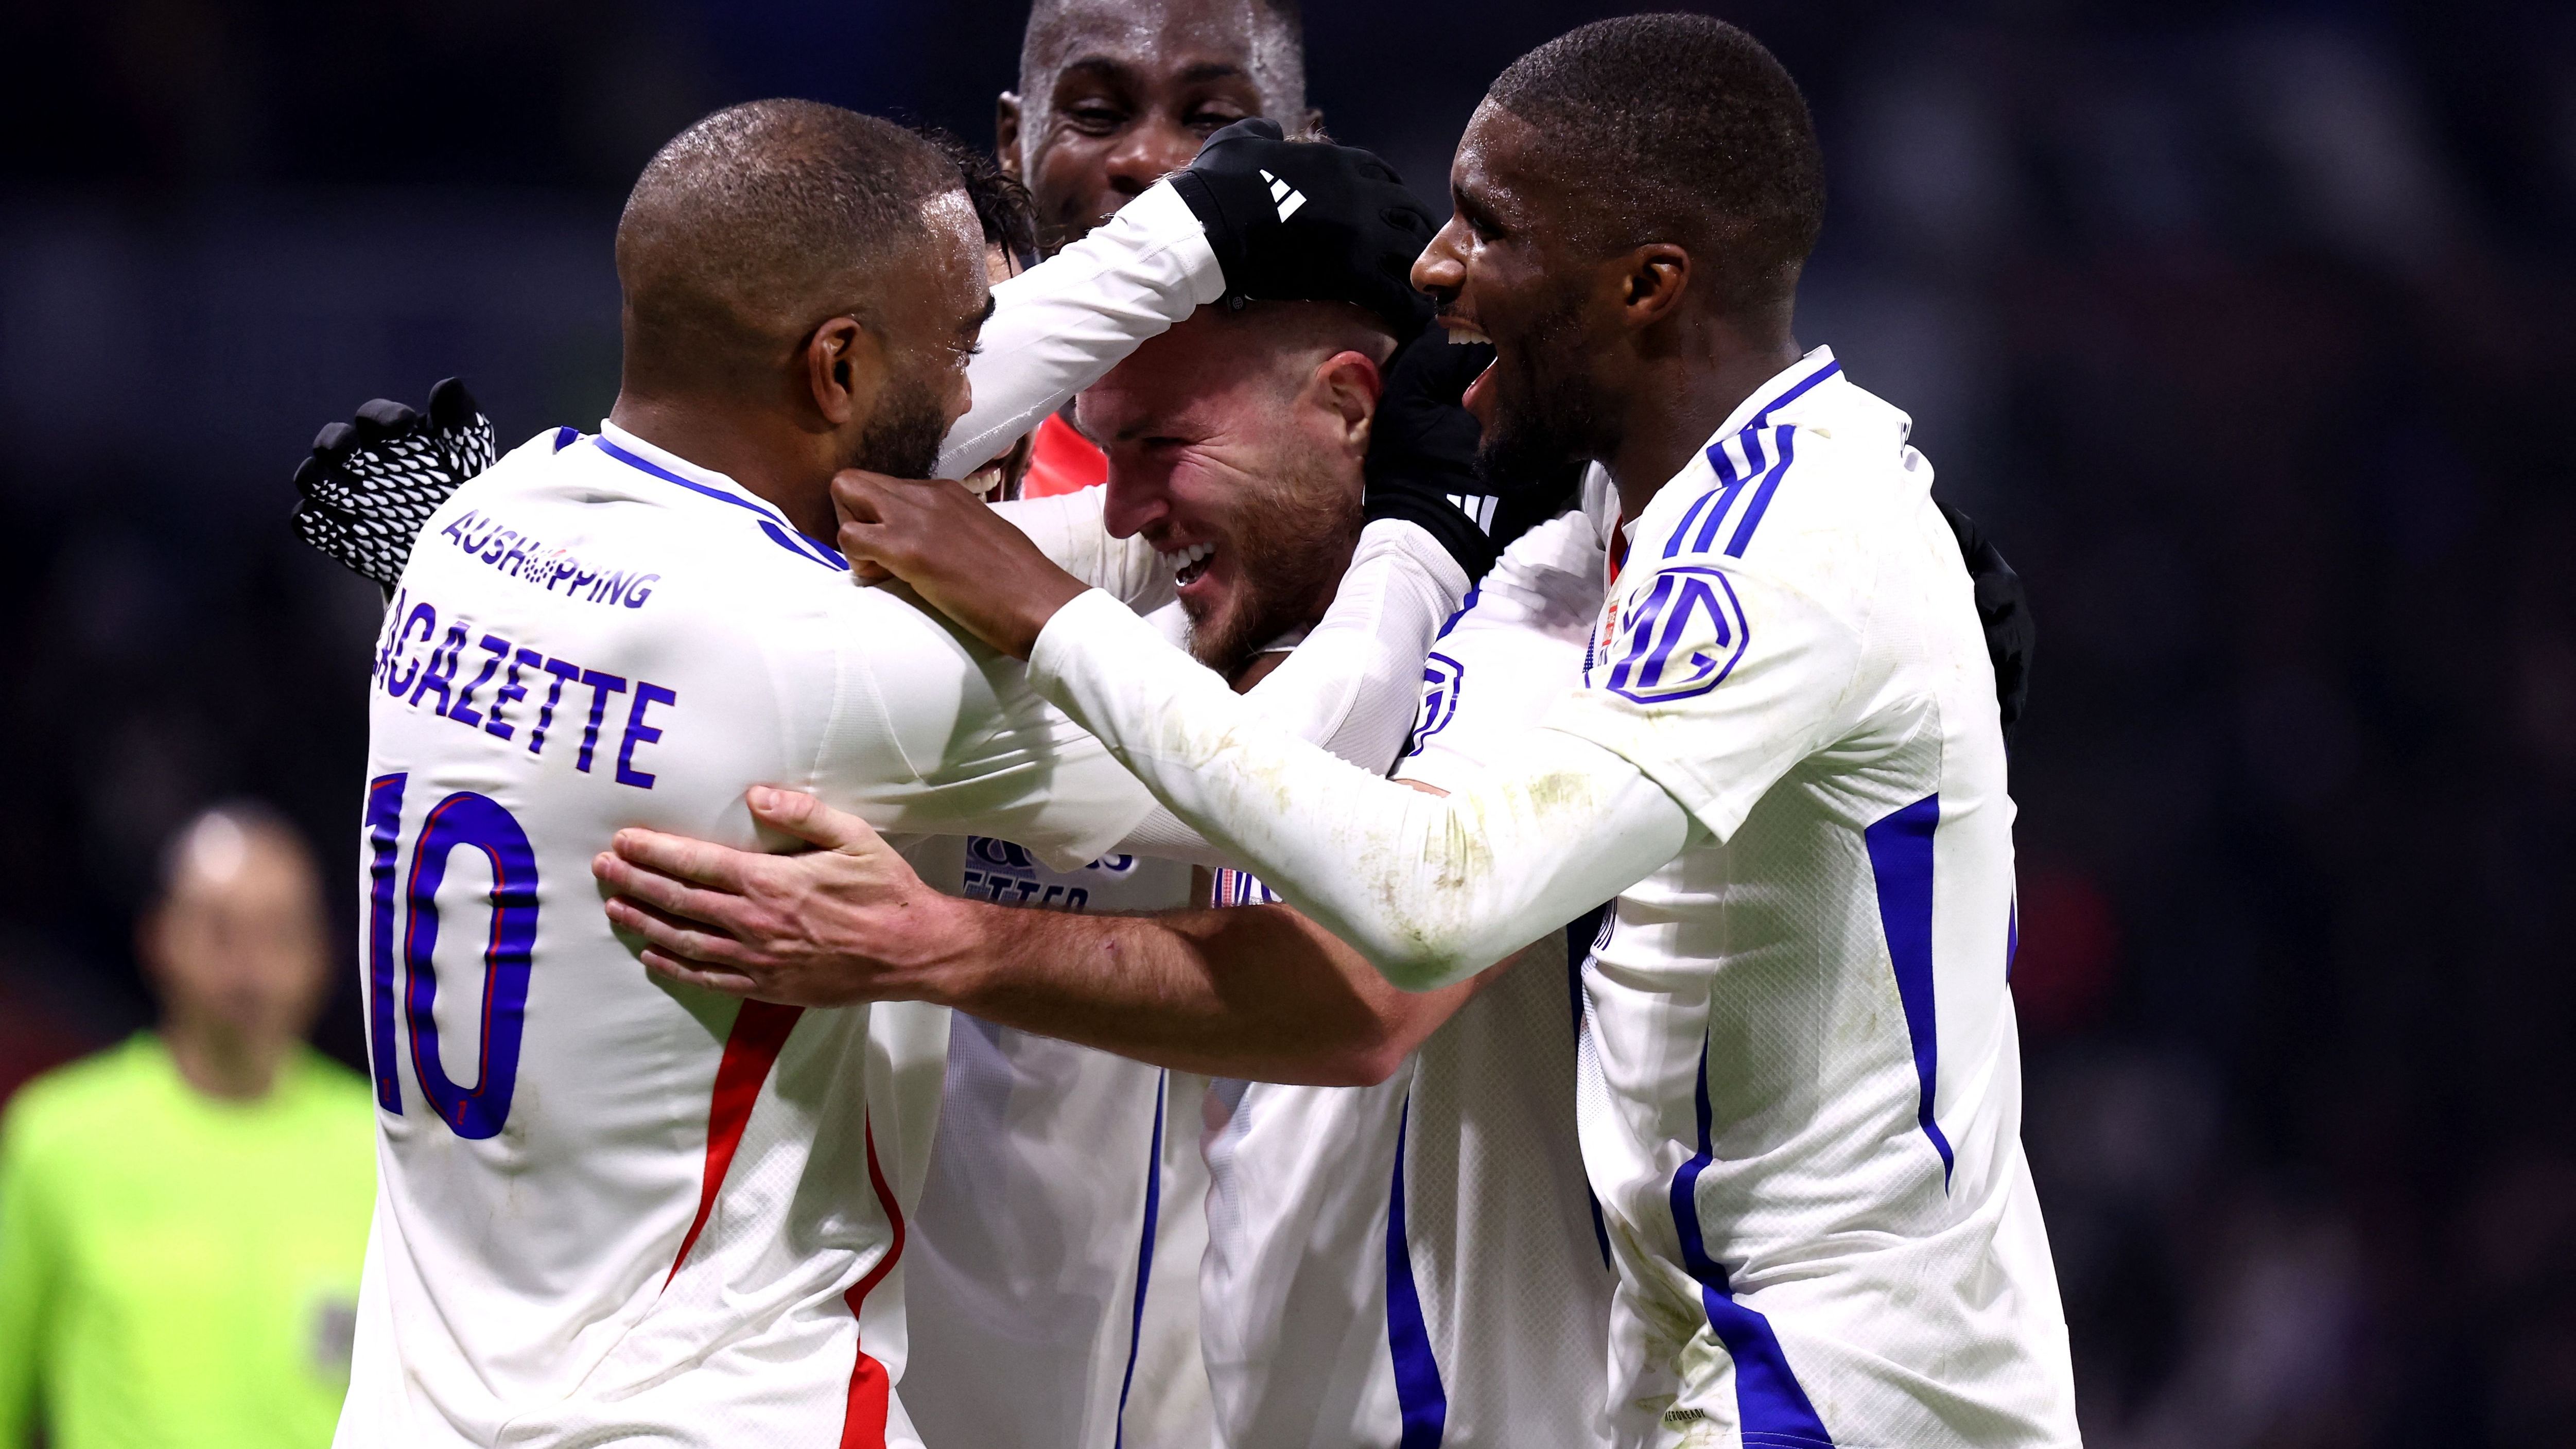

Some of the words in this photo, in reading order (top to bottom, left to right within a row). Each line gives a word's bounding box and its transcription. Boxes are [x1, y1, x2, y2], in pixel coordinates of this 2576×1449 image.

[373, 587, 676, 790] ACAZETTE
[365, 772, 539, 1140] 10
[1665, 1408, 1705, 1422] AEROREADY
